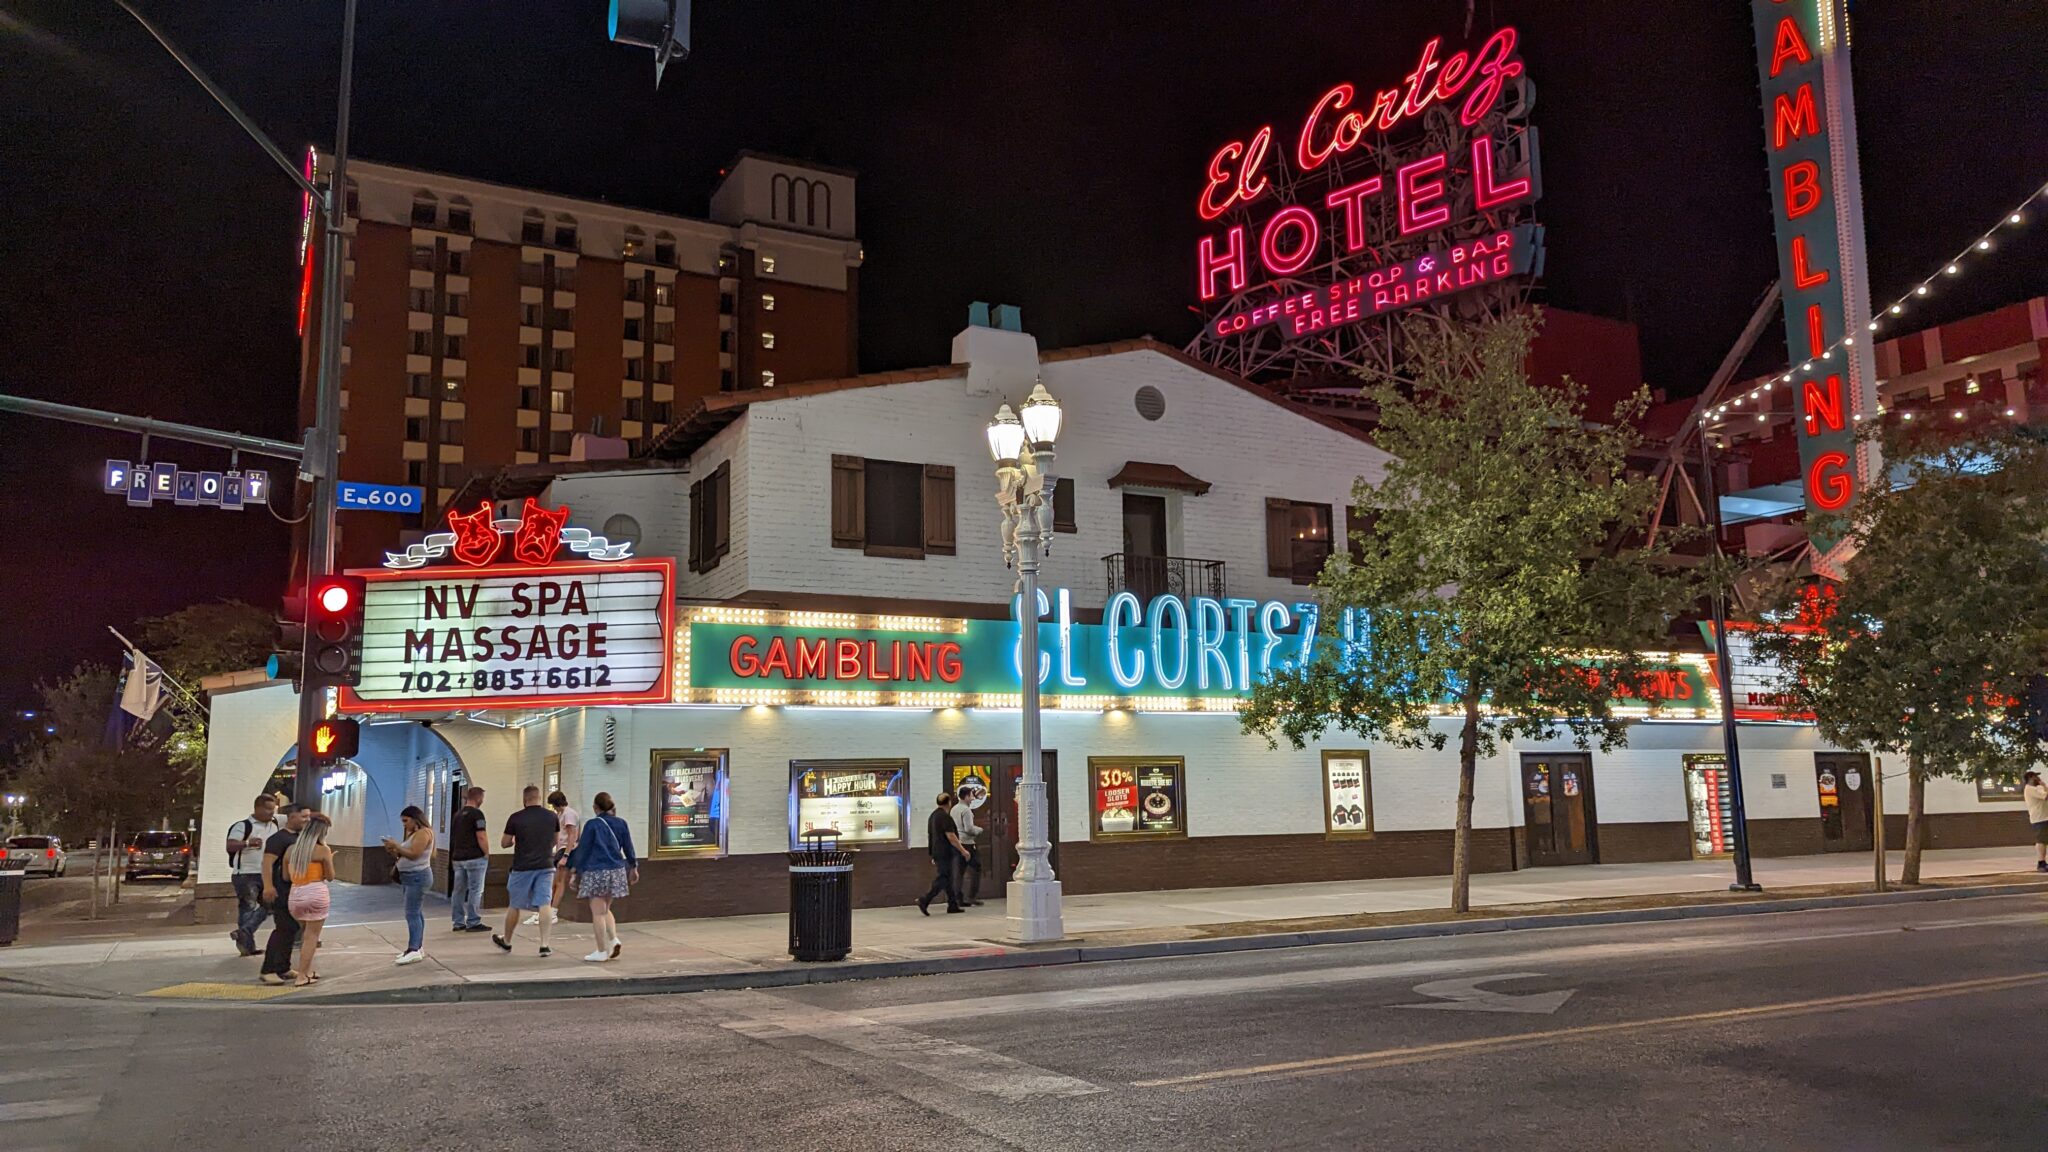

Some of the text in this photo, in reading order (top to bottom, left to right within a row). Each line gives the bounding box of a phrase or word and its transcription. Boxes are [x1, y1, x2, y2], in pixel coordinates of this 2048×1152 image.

[1199, 26, 1523, 220] El Cortez
[1200, 134, 1532, 300] HOTEL
[1768, 0, 1853, 511] AMBLING
[1217, 233, 1511, 336] COFFEE SHOP & BAR
[1295, 253, 1510, 335] FREE PARKING
[368, 490, 412, 507] 600
[424, 580, 589, 620] NV SPA
[403, 622, 608, 664] MASSAGE
[729, 634, 962, 683] GAMBLING
[824, 772, 877, 796] HAPPY HOUR
[1100, 768, 1133, 788] 30%
[1104, 788, 1130, 797] LOOSER
[1107, 794, 1128, 802] SLOTS
